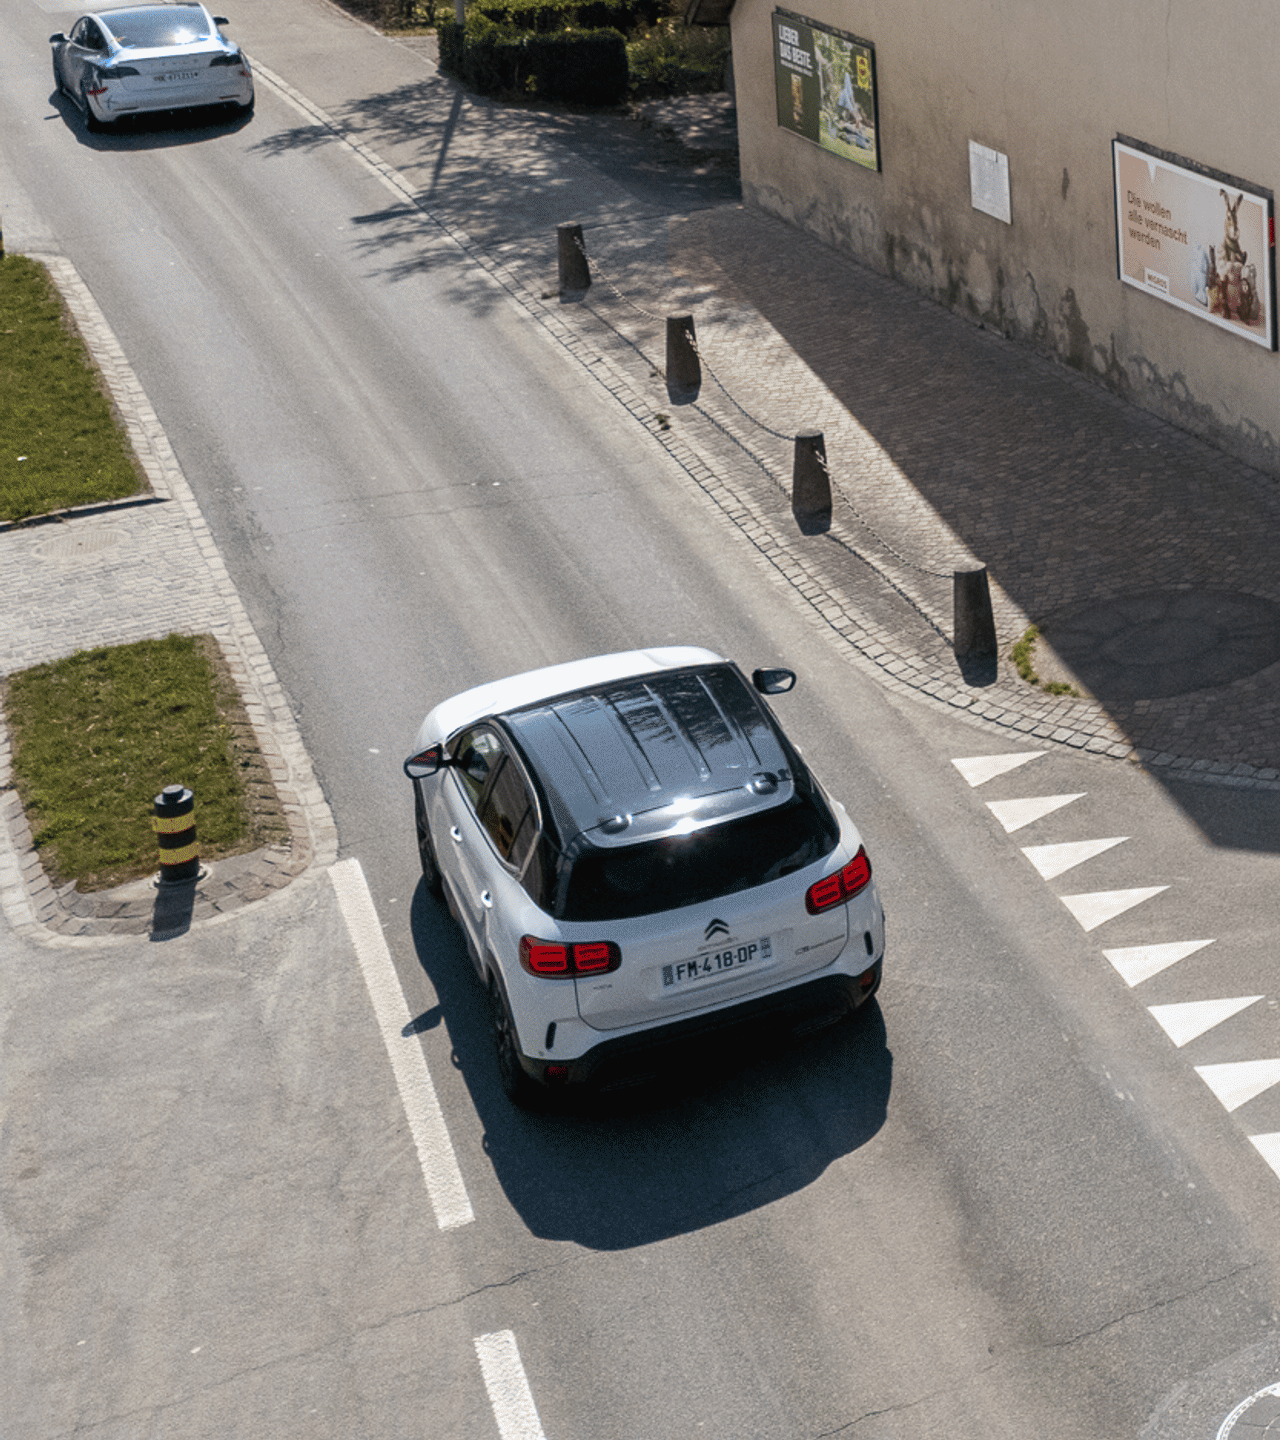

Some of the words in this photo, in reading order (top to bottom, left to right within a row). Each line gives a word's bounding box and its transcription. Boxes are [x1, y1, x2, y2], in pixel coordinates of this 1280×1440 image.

[779, 24, 800, 46] LIEBER
[780, 42, 791, 60] DAS
[1127, 189, 1141, 207] Die
[1143, 200, 1172, 221] wollen
[1127, 209, 1143, 226] alle
[1144, 217, 1188, 245] vernascht
[1128, 226, 1160, 250] werden
[675, 943, 758, 981] FM-418-DP
